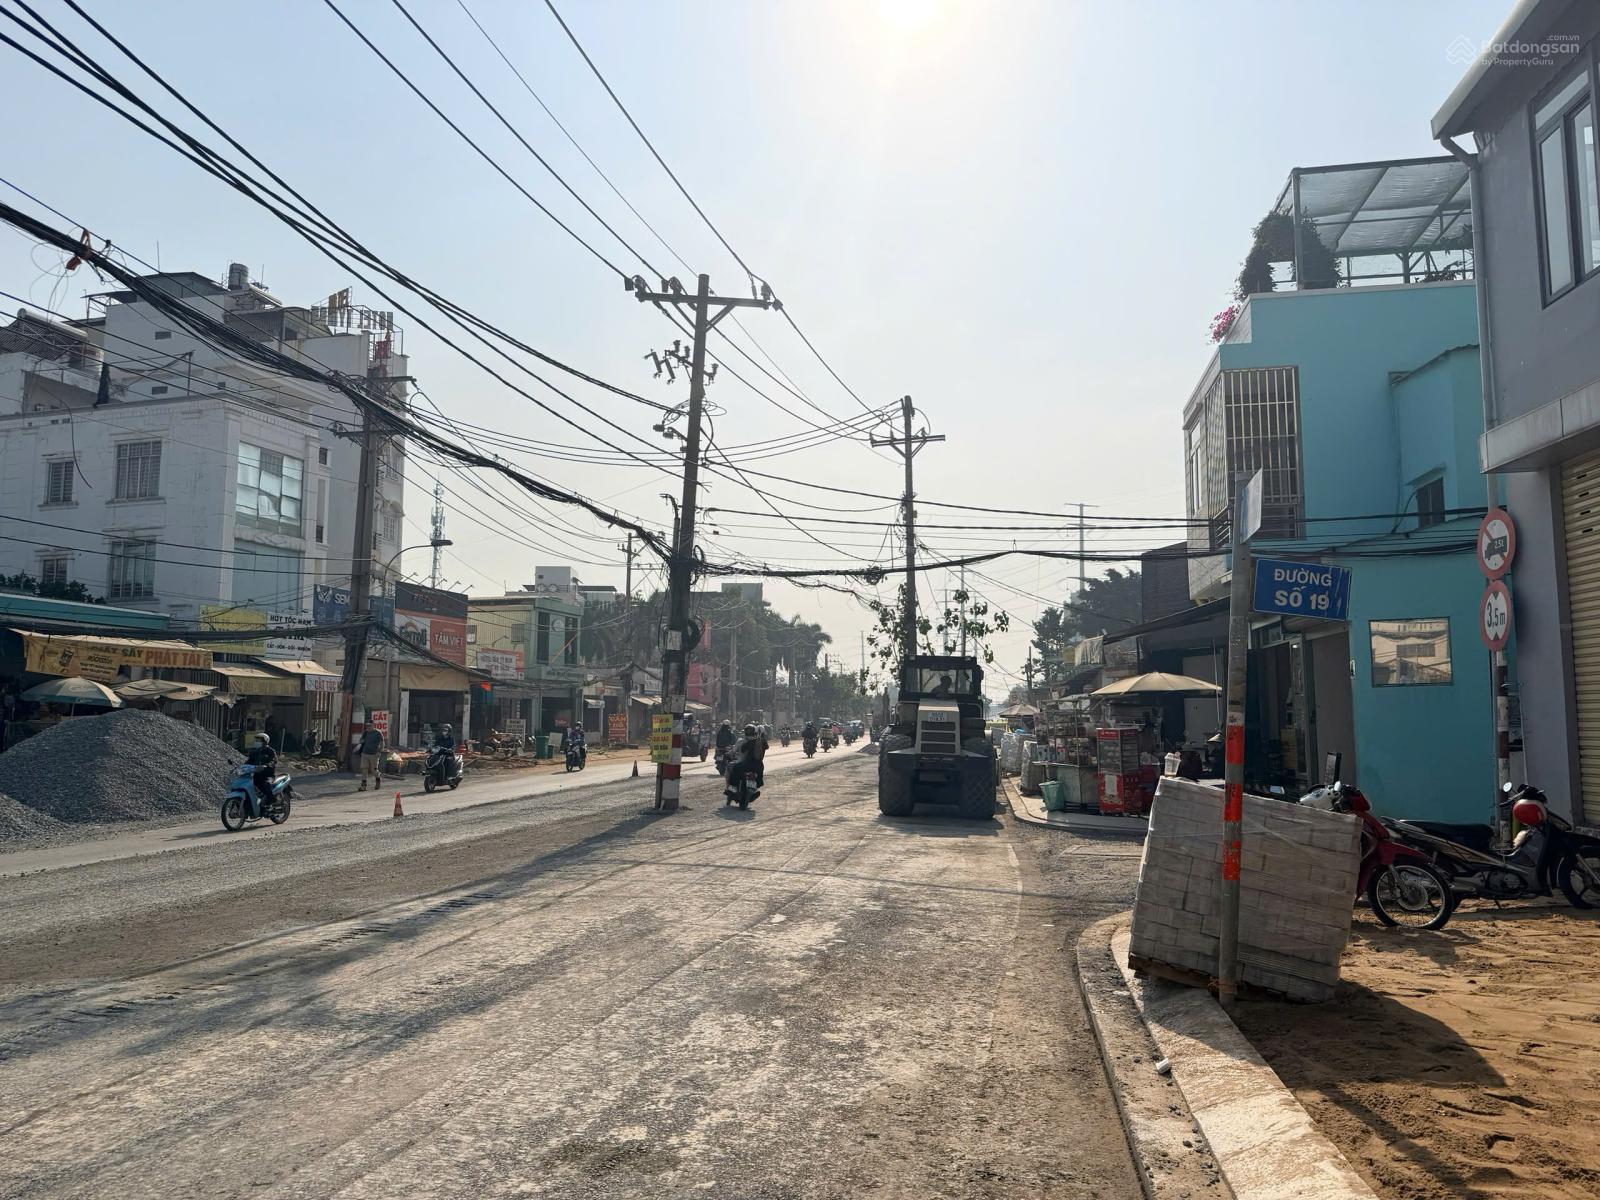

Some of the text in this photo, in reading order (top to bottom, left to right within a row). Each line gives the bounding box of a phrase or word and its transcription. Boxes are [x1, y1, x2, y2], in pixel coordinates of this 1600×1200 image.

[1274, 568, 1332, 587] ĐƯỜNG
[1274, 586, 1330, 610] SỐ 19
[145, 648, 178, 666] PHÁT
[373, 711, 388, 720] CẮT
